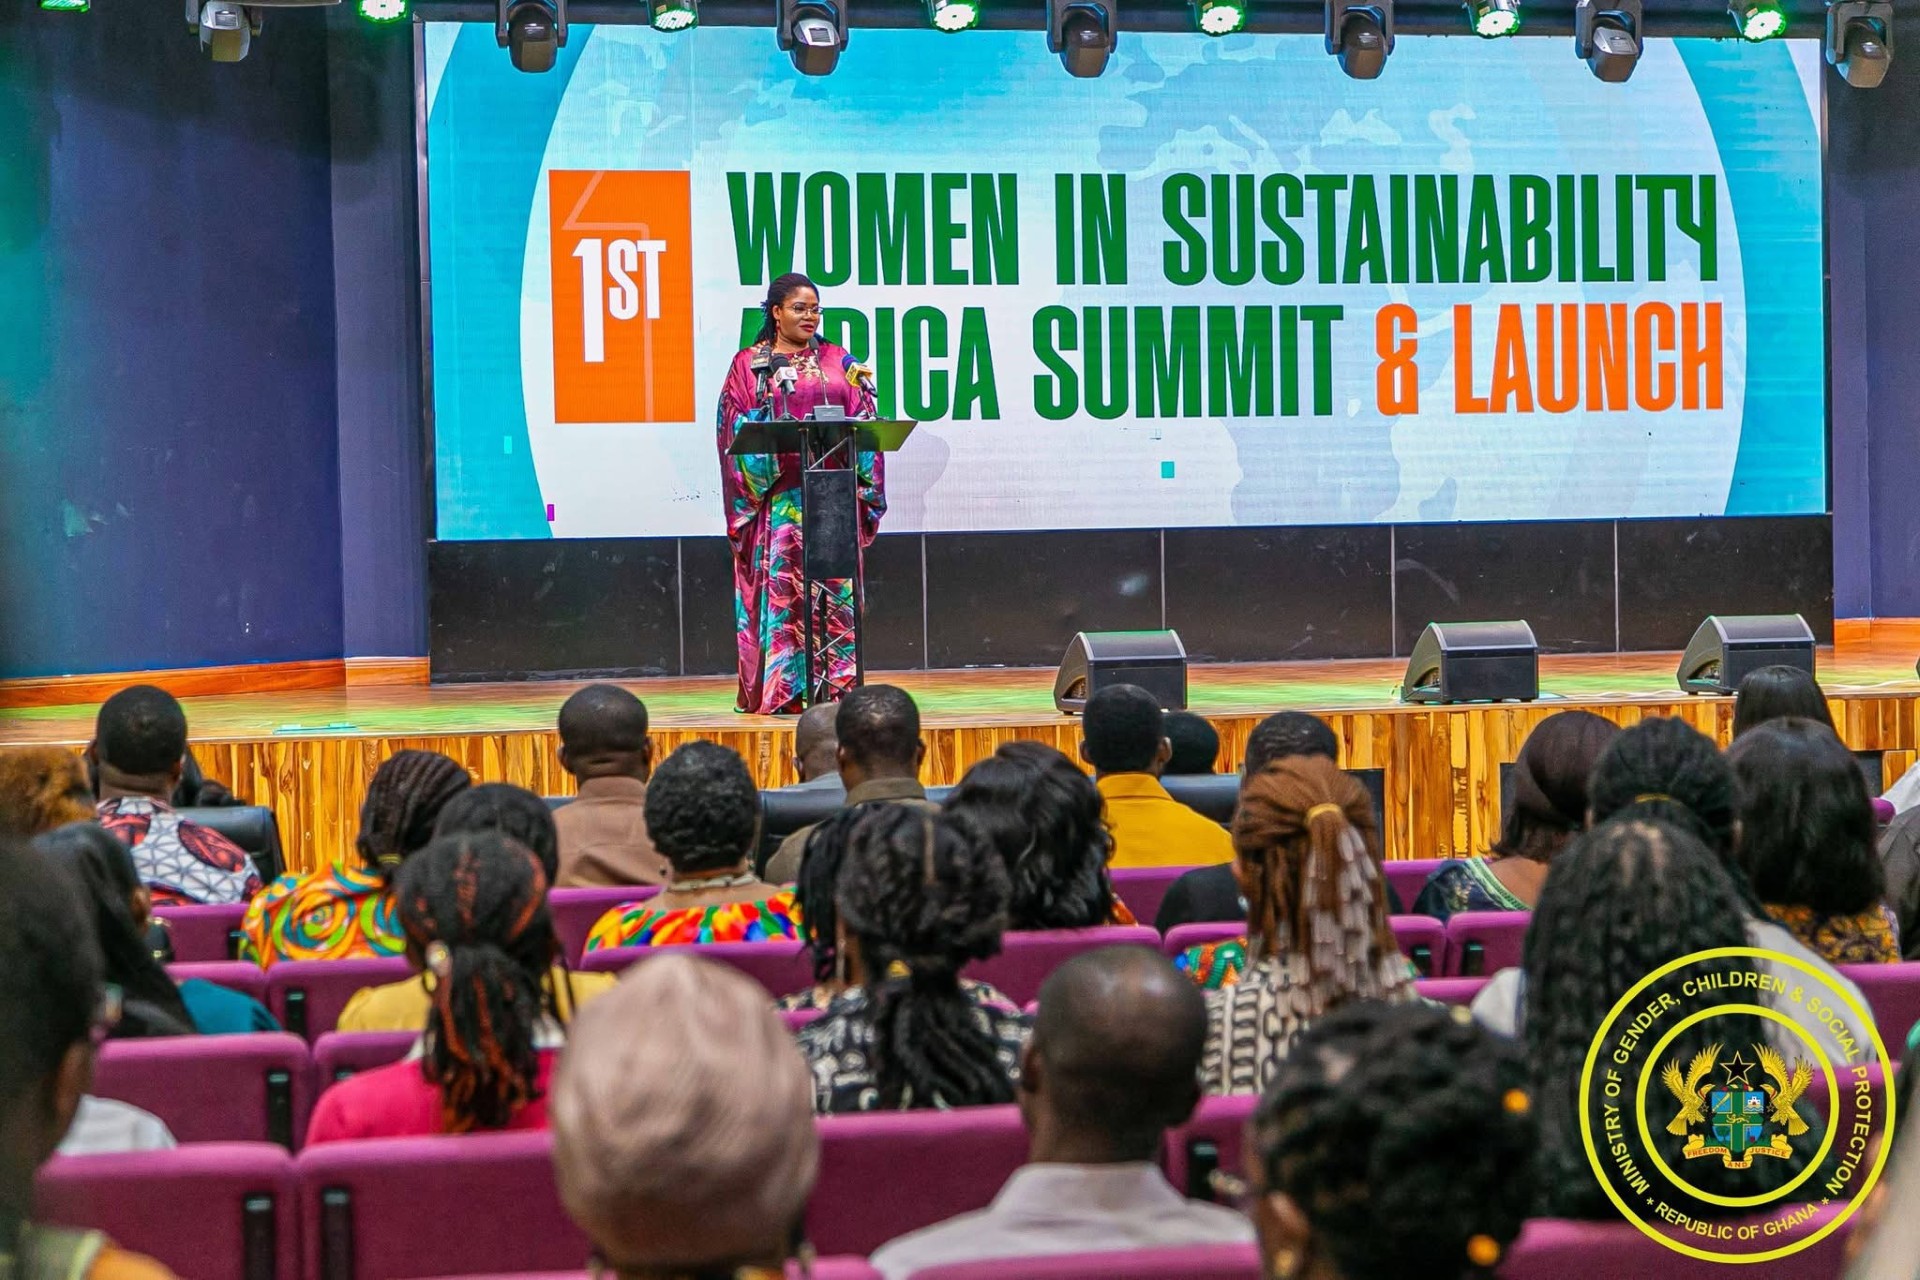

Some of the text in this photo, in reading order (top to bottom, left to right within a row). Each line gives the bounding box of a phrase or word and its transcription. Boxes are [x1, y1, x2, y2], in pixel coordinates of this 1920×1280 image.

[727, 171, 1718, 287] WOMEN IN SUSTAINABILITY
[573, 238, 666, 362] 1ST
[739, 302, 1723, 421] ICA SUMMIT & LAUNCH
